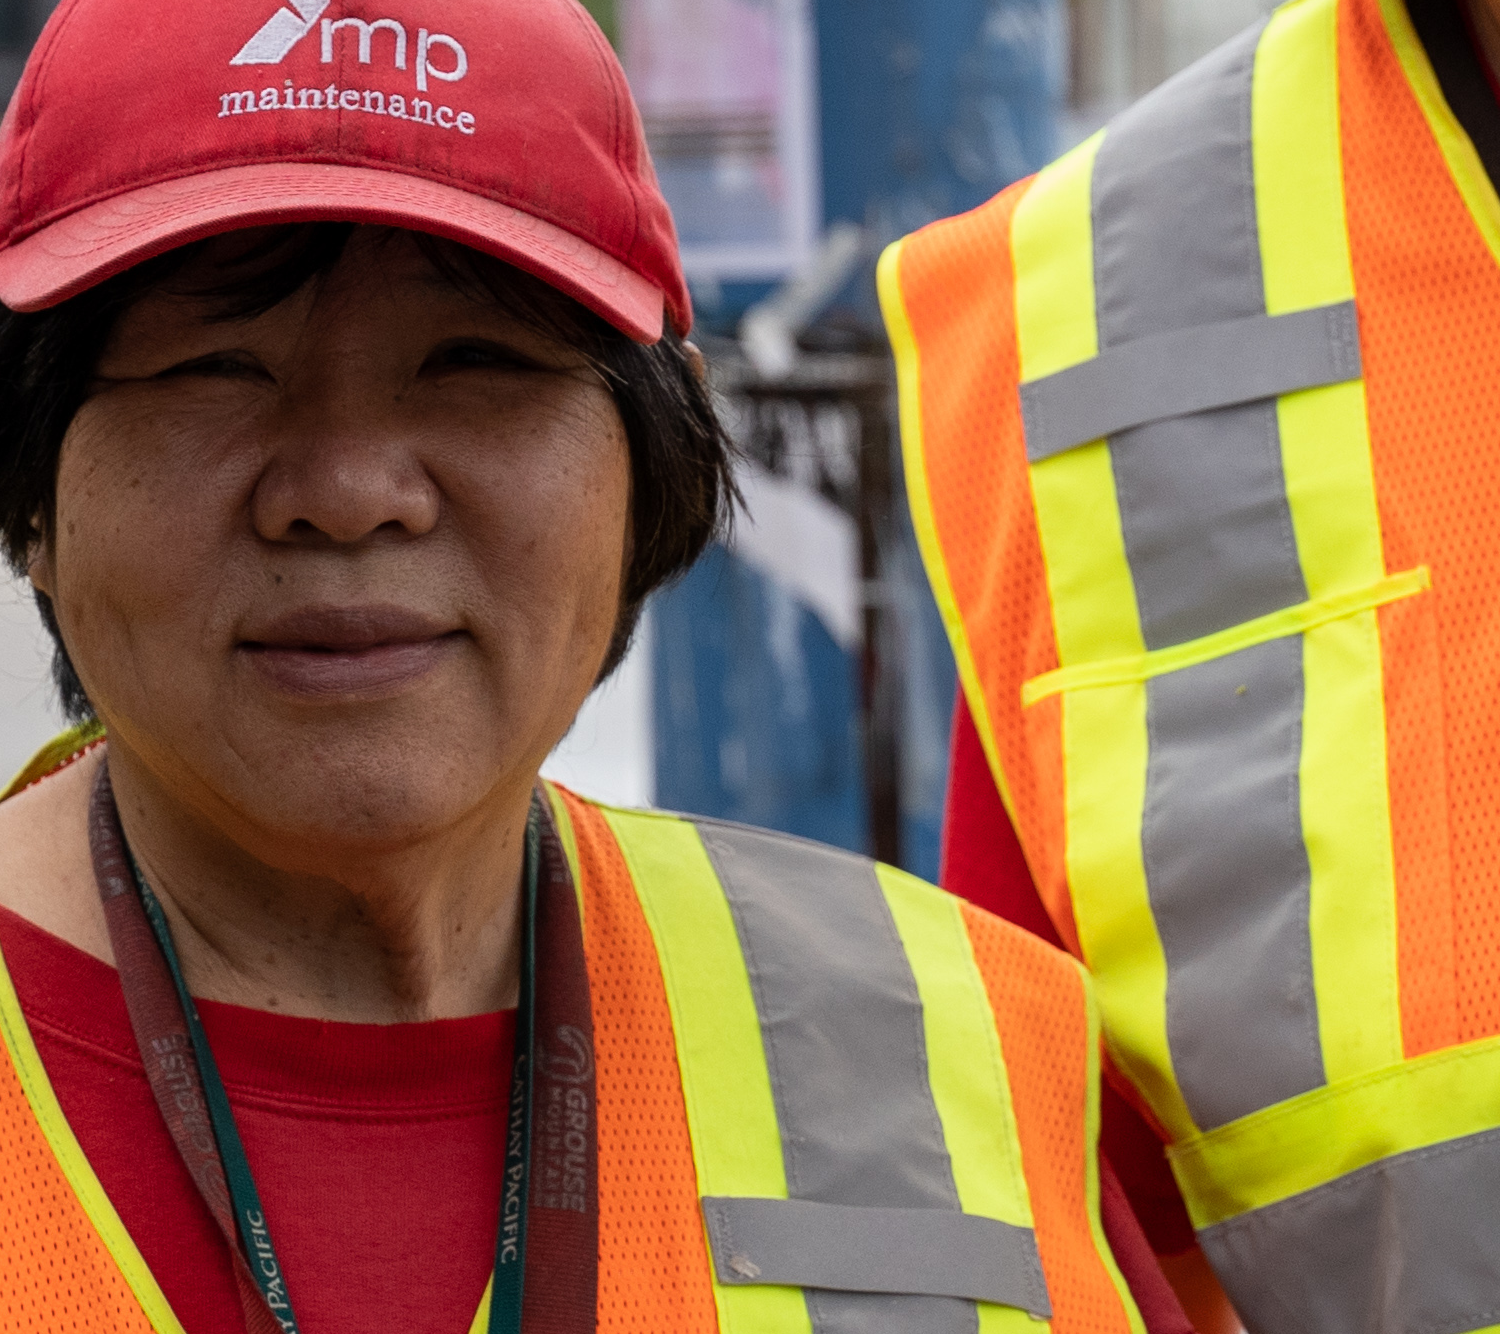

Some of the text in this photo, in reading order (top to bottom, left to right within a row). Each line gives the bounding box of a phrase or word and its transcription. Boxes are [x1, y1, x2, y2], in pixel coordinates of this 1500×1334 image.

[319, 17, 469, 92] mp
[217, 78, 476, 135] maintenance
[501, 1054, 527, 1264] CATHAY PACIFIC
[562, 1087, 588, 1213] GROUSE
[246, 1209, 289, 1309] PACIFIC
